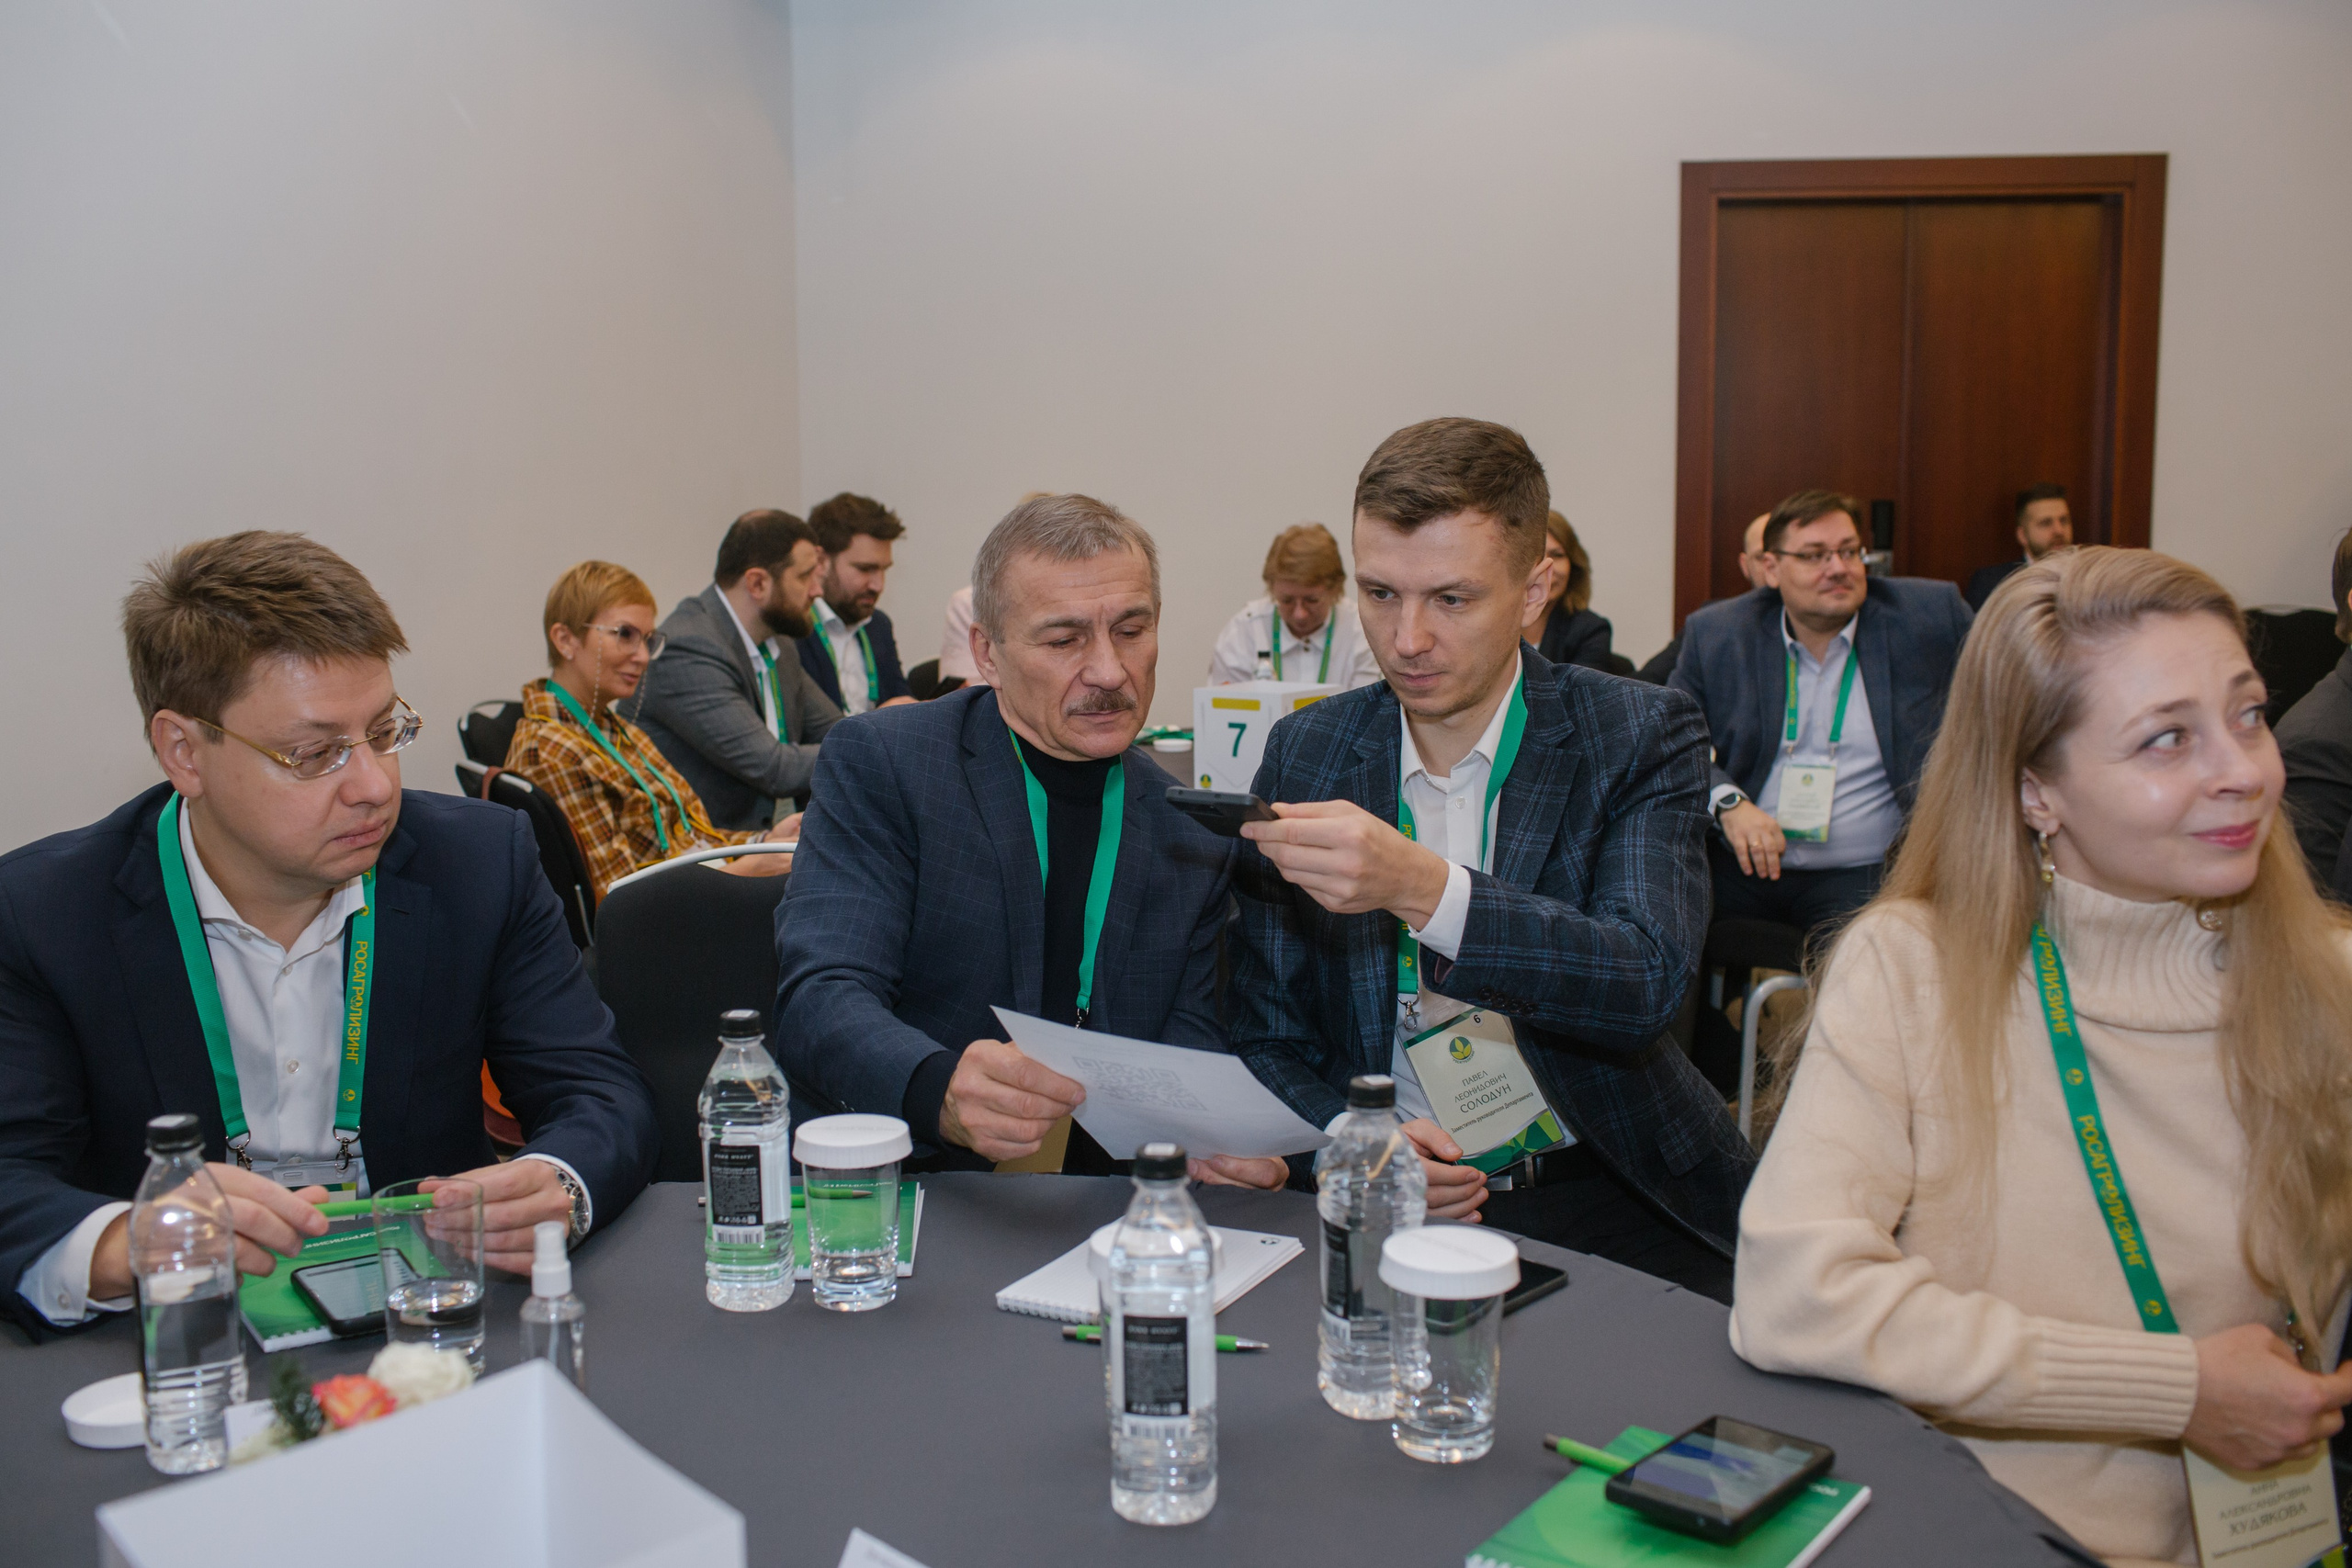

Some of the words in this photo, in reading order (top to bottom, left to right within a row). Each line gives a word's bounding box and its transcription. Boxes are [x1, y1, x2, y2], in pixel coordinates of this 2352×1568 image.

[1227, 722, 1247, 757] 7
[345, 941, 368, 1065] РОСАГРОЛИЗИНГ
[1473, 1014, 1481, 1024] 6
[1454, 1073, 1508, 1103] ЛЕОНИДОВИЧ
[1462, 1070, 1488, 1087] ПАВЕЛ
[1460, 1084, 1512, 1113] СОЛОДУН
[2076, 1114, 2147, 1269] РОСАГРОЛИЗИНГ
[2230, 1502, 2307, 1536] ХУДЯКОВА
